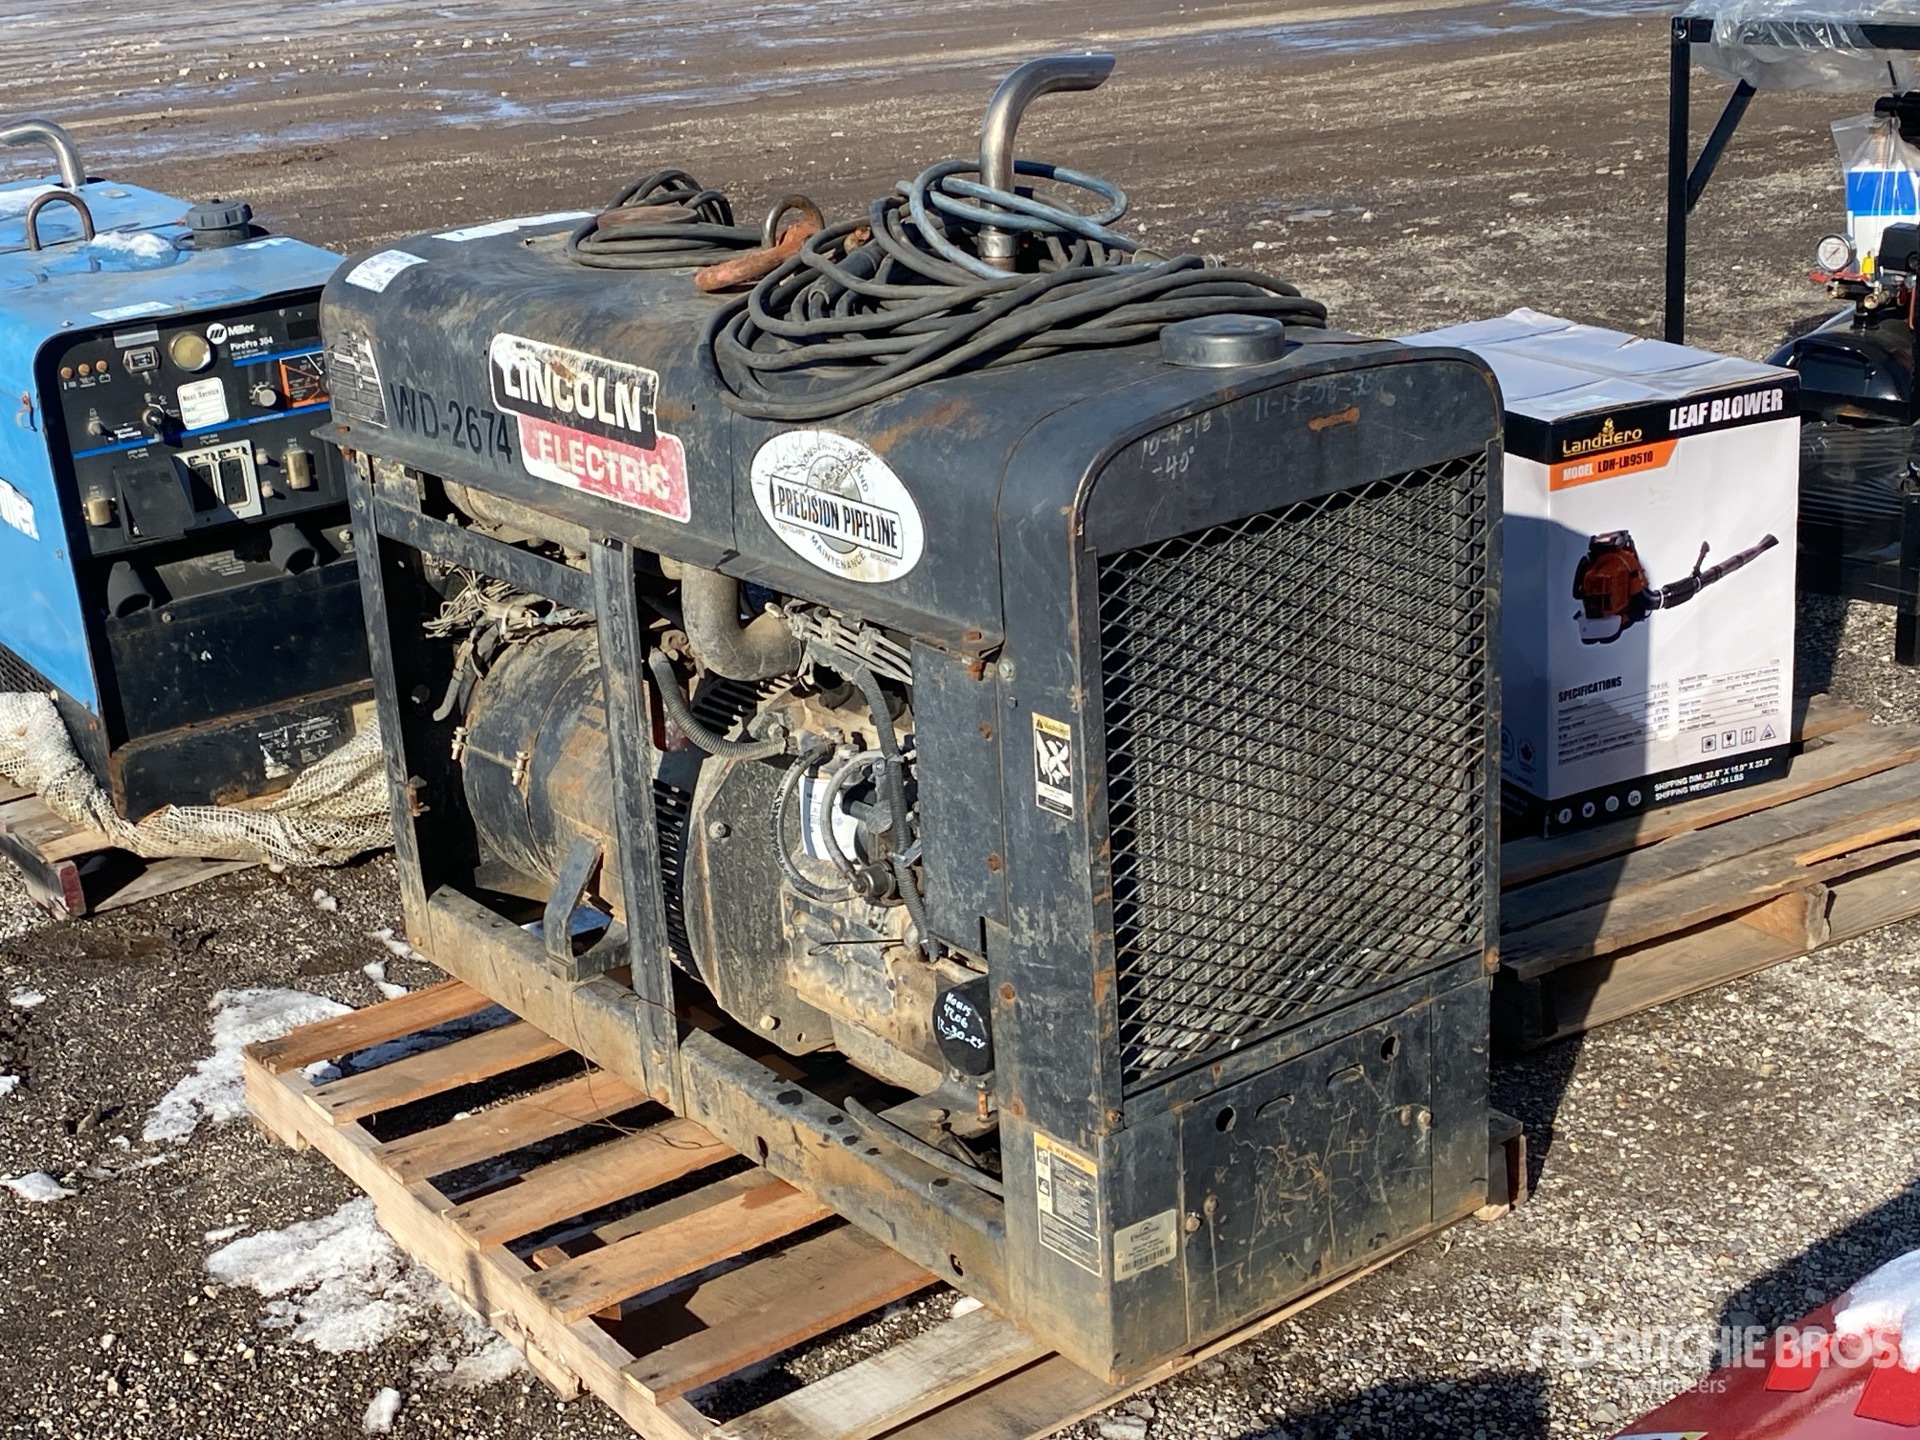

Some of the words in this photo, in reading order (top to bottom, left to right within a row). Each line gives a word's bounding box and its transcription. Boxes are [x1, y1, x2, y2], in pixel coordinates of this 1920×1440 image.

[228, 324, 255, 336] Miller
[198, 389, 220, 399] Service
[500, 354, 642, 433] LINCOLN
[1669, 402, 1709, 431] LEAF
[1710, 388, 1783, 422] BLOWER
[389, 382, 512, 464] WD-2674
[536, 429, 671, 501] ELECTRIC
[1563, 463, 1594, 481] MODEL
[1598, 450, 1653, 473] LDH-LB9510
[778, 484, 839, 531] PRECISION
[842, 504, 898, 550] PIPELINE
[810, 535, 867, 571] MAINTENANCE
[1558, 676, 1622, 702] SPECIFICATIONS
[1654, 776, 1688, 792] SHIPPING
[1655, 785, 1689, 801] SHIPPING
[1730, 773, 1744, 783] LBS
